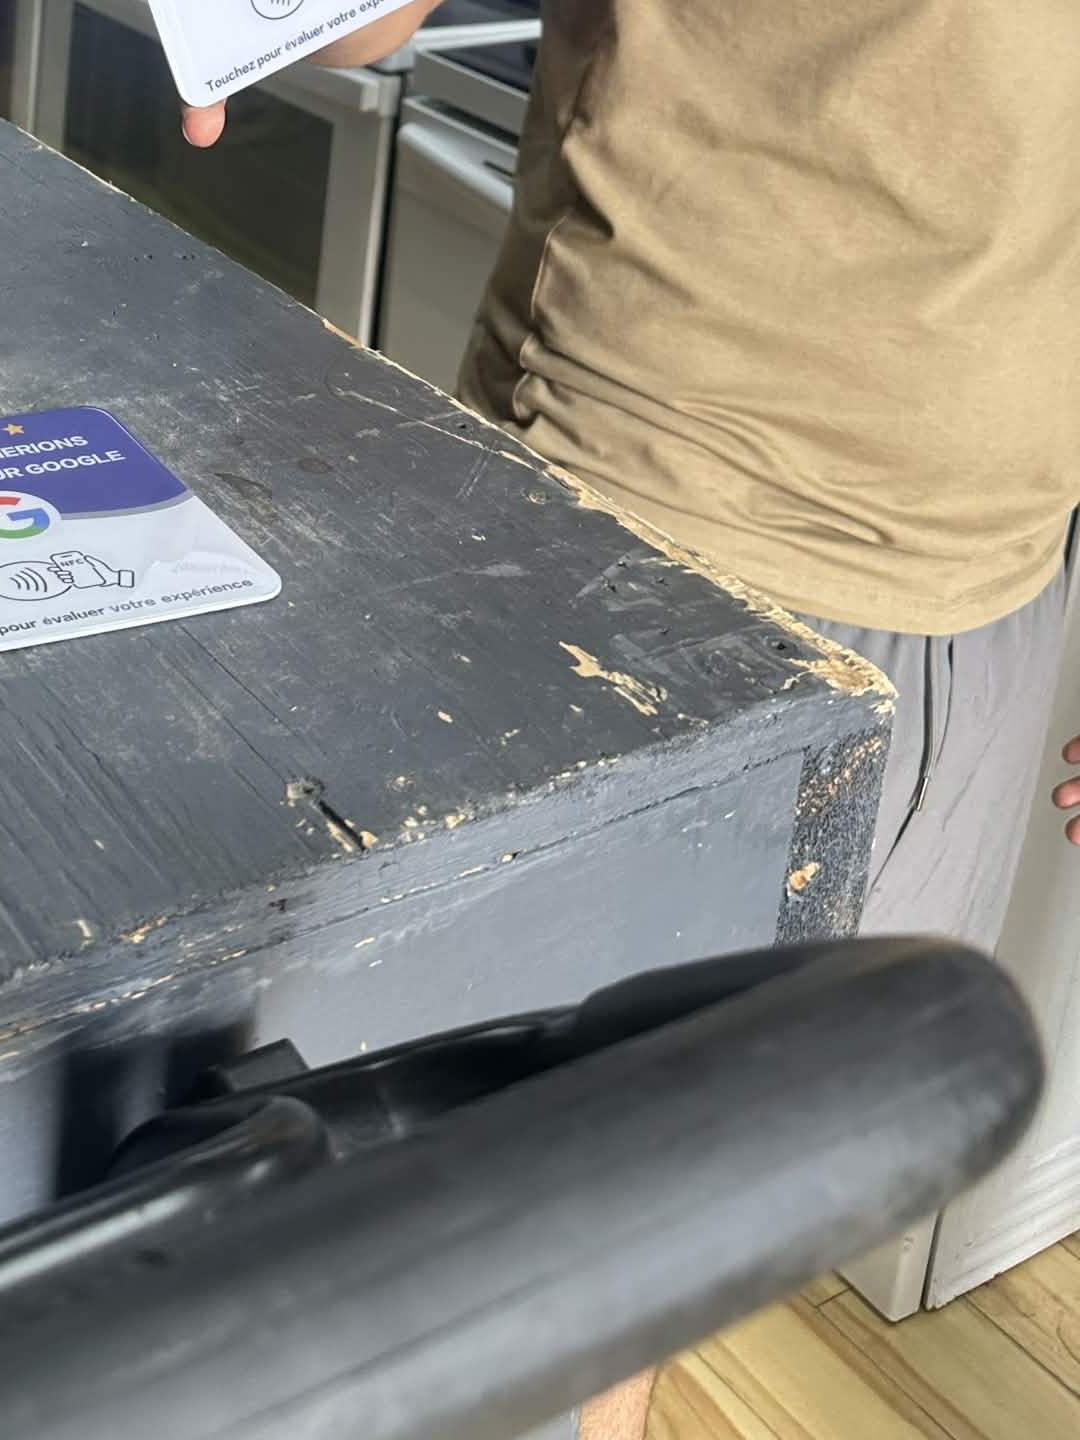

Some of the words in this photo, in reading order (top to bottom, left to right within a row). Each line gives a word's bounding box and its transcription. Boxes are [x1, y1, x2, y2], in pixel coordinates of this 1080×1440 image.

[205, 60, 256, 92] Touchez
[256, 46, 282, 69] pour
[284, 24, 325, 51] évaluer
[326, 8, 357, 30] votre
[24, 450, 126, 476] GOOGLE
[59, 557, 84, 568] NFC
[42, 606, 105, 626] évaluer
[109, 596, 156, 614] votre
[160, 577, 254, 603] expérience
